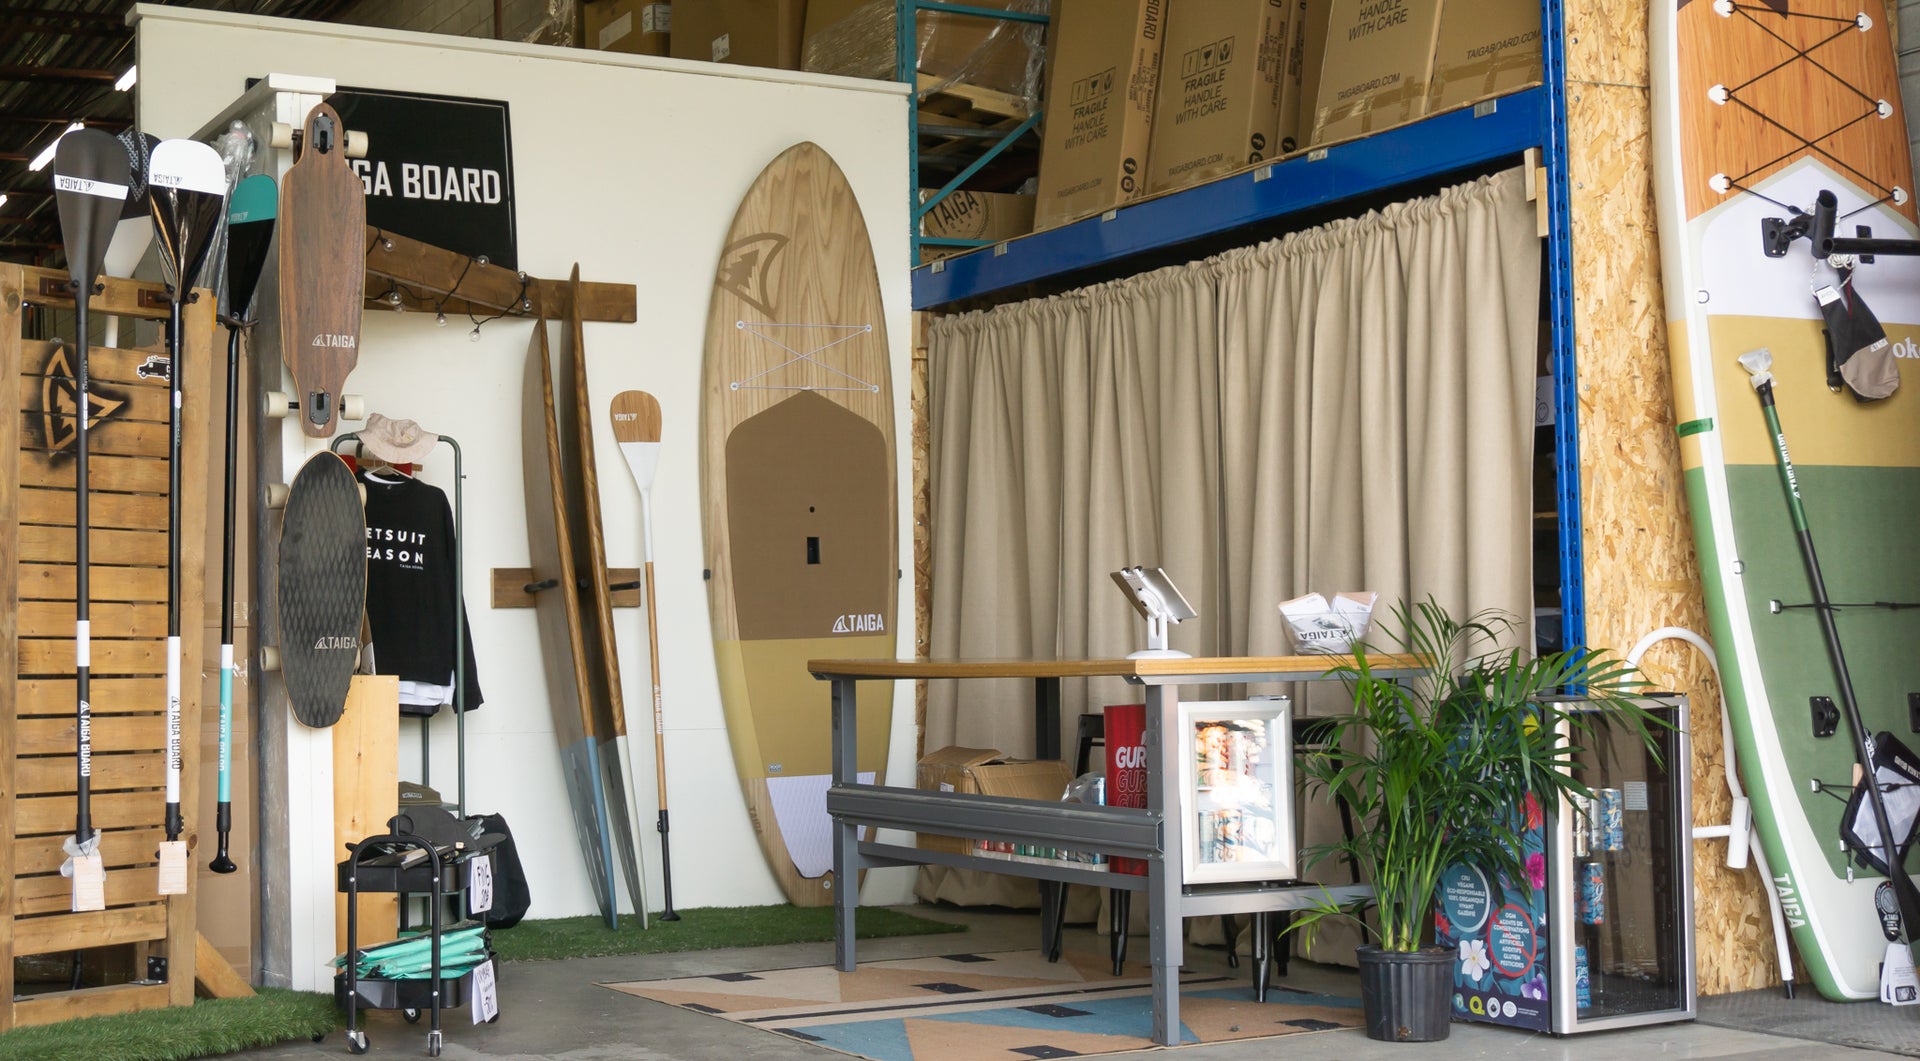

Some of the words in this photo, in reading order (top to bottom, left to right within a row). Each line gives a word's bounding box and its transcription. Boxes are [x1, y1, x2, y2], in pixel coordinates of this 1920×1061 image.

[1143, 0, 1160, 40] BOARD
[1359, 0, 1402, 21] HANDLE
[1349, 20, 1376, 42] WITH
[1377, 8, 1408, 31] CARE
[1467, 28, 1542, 60] TAIGABOARD.COM
[1185, 69, 1226, 93] FRAGILE
[1337, 72, 1401, 101] TAIGABOARD.COM
[1184, 85, 1222, 108] HANDLE
[1073, 98, 1108, 120] FRAGILE
[1176, 108, 1199, 126] WITH
[1200, 98, 1228, 117] CARE
[1073, 113, 1105, 134] HANDLE
[1064, 135, 1086, 151] WITH
[1087, 125, 1108, 143] CARE
[60, 177, 82, 190] TAIGA
[153, 173, 177, 185] TAIGA
[345, 158, 393, 197] GA
[402, 163, 501, 204] BOARD
[930, 189, 979, 229] TAIGA
[326, 334, 355, 349] TAIGA
[1892, 336, 1920, 359] ok
[365, 527, 425, 545] ETSUIT
[366, 547, 423, 564] EASON
[848, 613, 884, 632] TAIGA
[328, 636, 358, 649] TAIGA
[1300, 630, 1335, 640] TAIGA
[80, 713, 91, 742] TAIGA
[171, 710, 181, 736] TAIGA
[80, 743, 91, 777] BOARD
[171, 738, 181, 770] BOARD
[1115, 746, 1147, 769] GUR
[1116, 769, 1148, 793] GUR
[1446, 887, 1486, 897] ÉCO-RESPONSABLE
[1459, 896, 1484, 904] ORGANIQUE
[1773, 873, 1806, 928] TAIGA
[1502, 946, 1521, 954] ADDITIFS
[1503, 953, 1520, 961] GLUTEN
[1500, 960, 1524, 969] PESTICIDES
